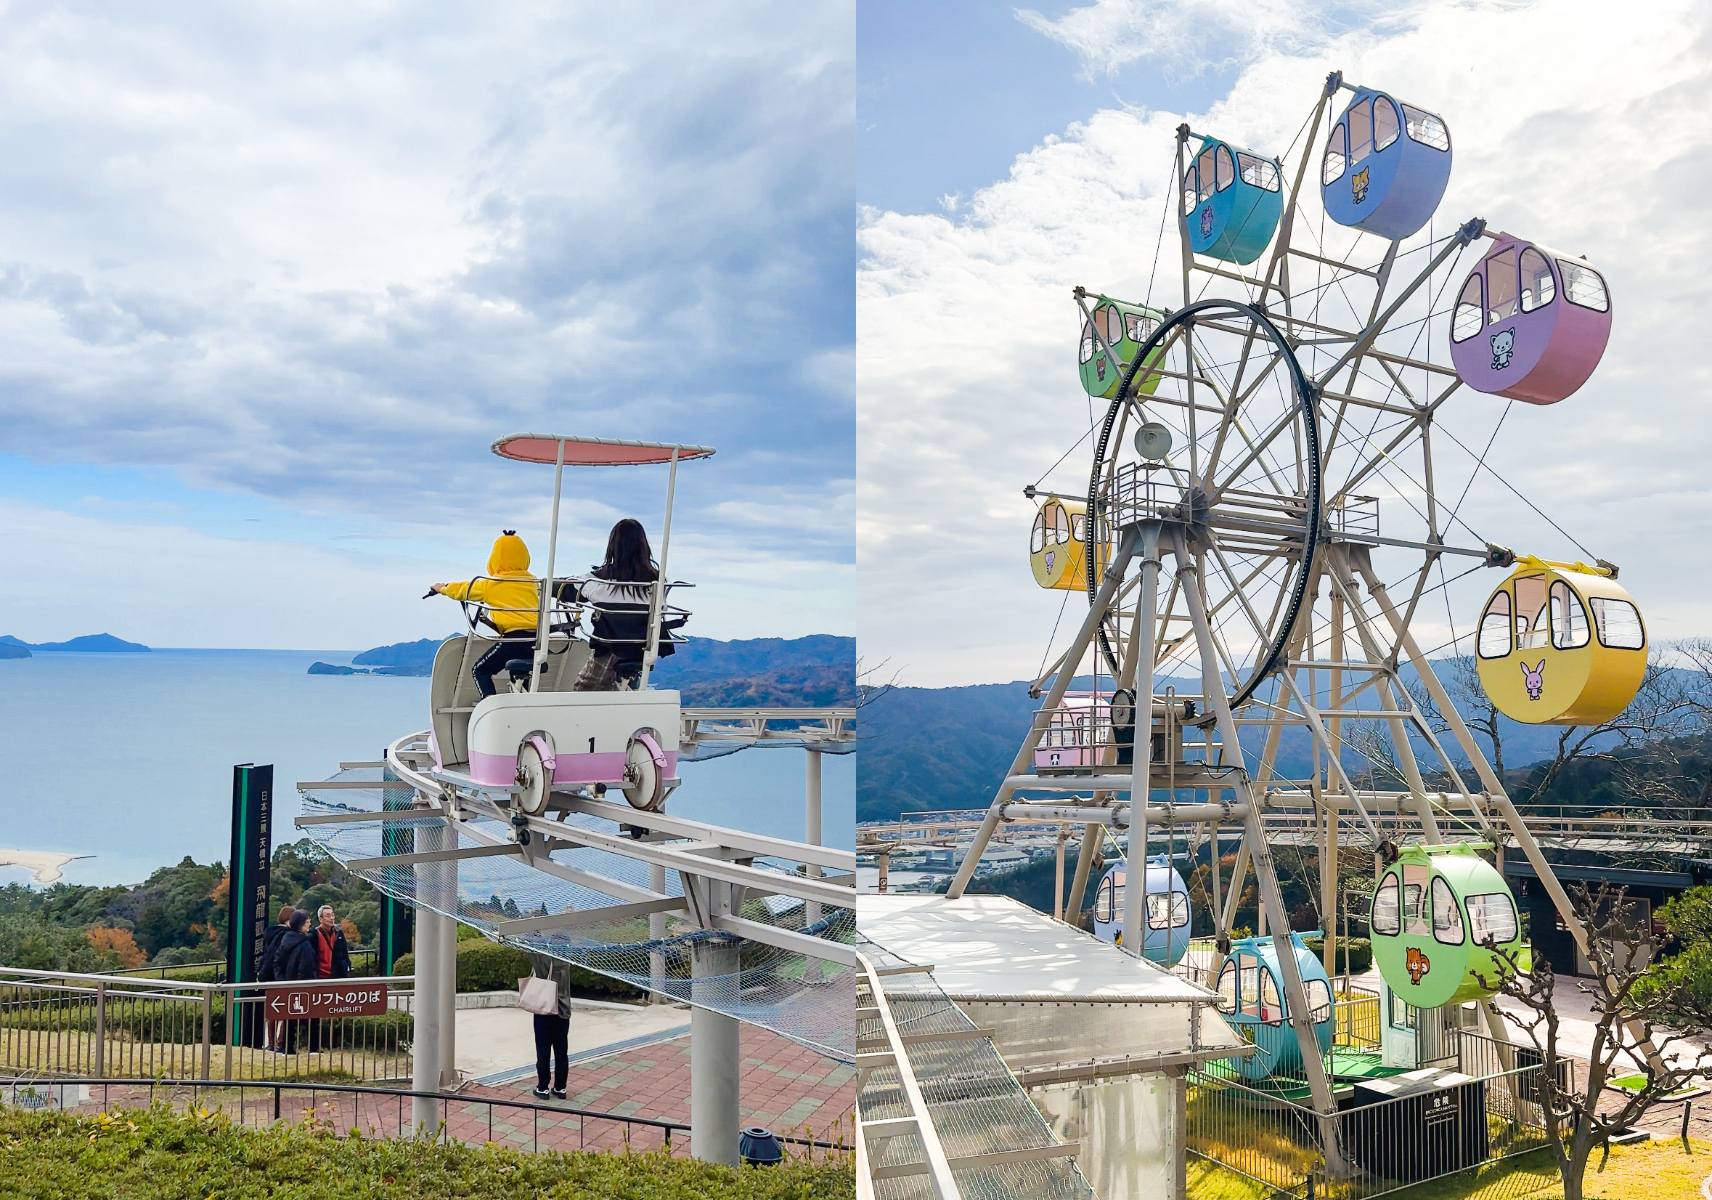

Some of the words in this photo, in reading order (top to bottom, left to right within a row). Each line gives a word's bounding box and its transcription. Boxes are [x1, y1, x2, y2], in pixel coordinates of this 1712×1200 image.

[588, 736, 596, 754] 1
[312, 989, 381, 1006] リフトのりば
[328, 1006, 363, 1014] CHAIRLIFT
[1433, 1095, 1450, 1108] 危険
